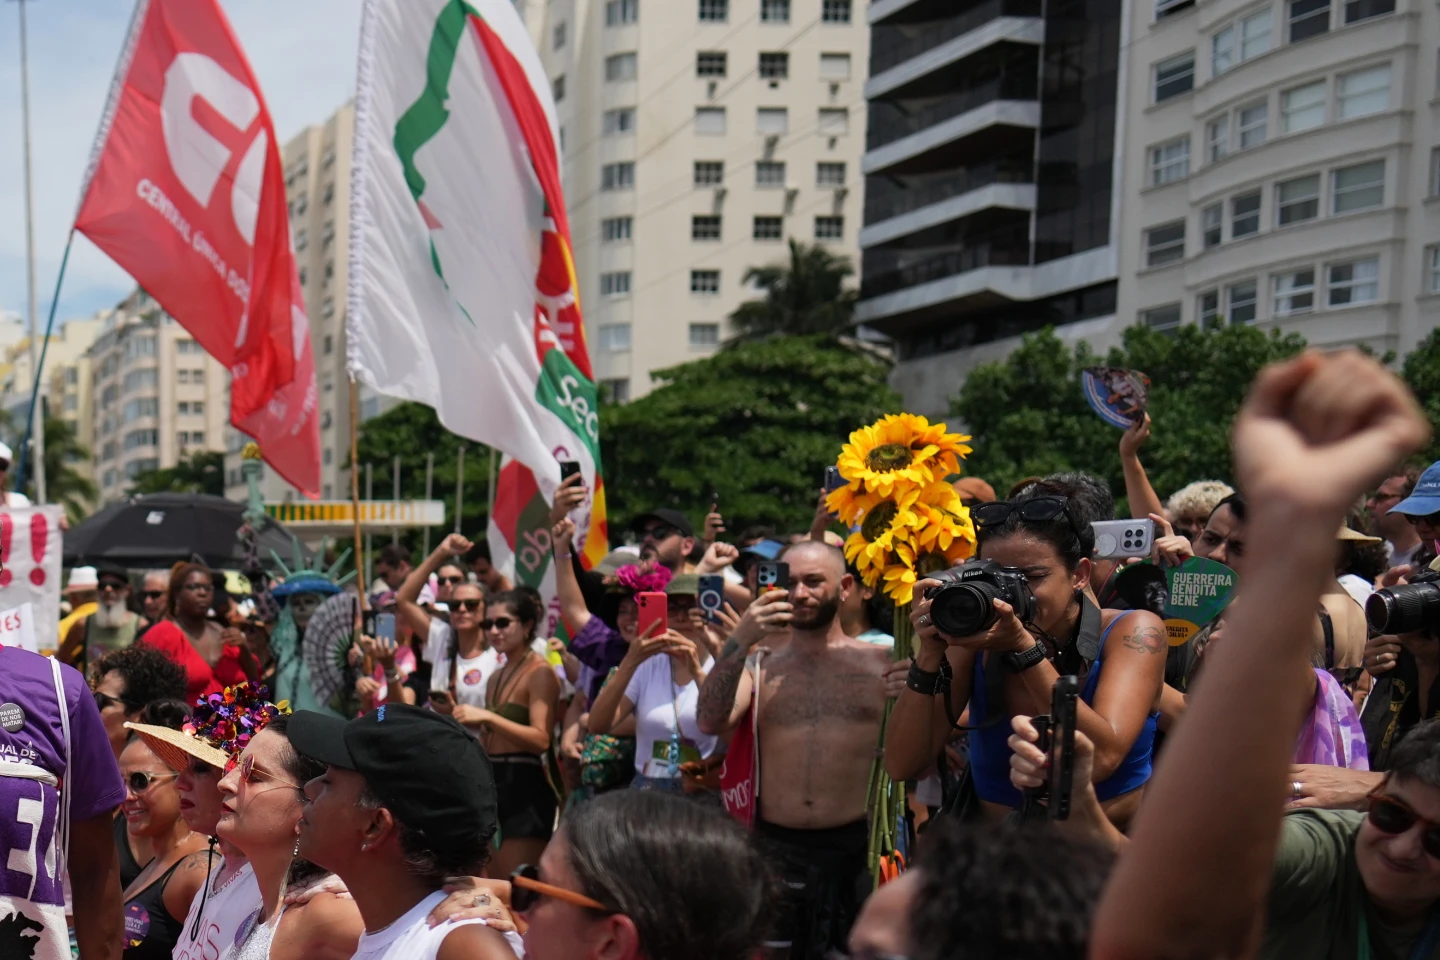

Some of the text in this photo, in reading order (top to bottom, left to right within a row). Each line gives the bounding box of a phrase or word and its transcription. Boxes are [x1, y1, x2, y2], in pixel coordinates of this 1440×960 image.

[963, 569, 983, 578] Nikon
[1172, 571, 1233, 587] GUERREIRA
[1171, 583, 1217, 597] BENDITA
[0, 708, 21, 717] PAREM
[9, 713, 22, 721] NOS
[20, 748, 37, 760] DE
